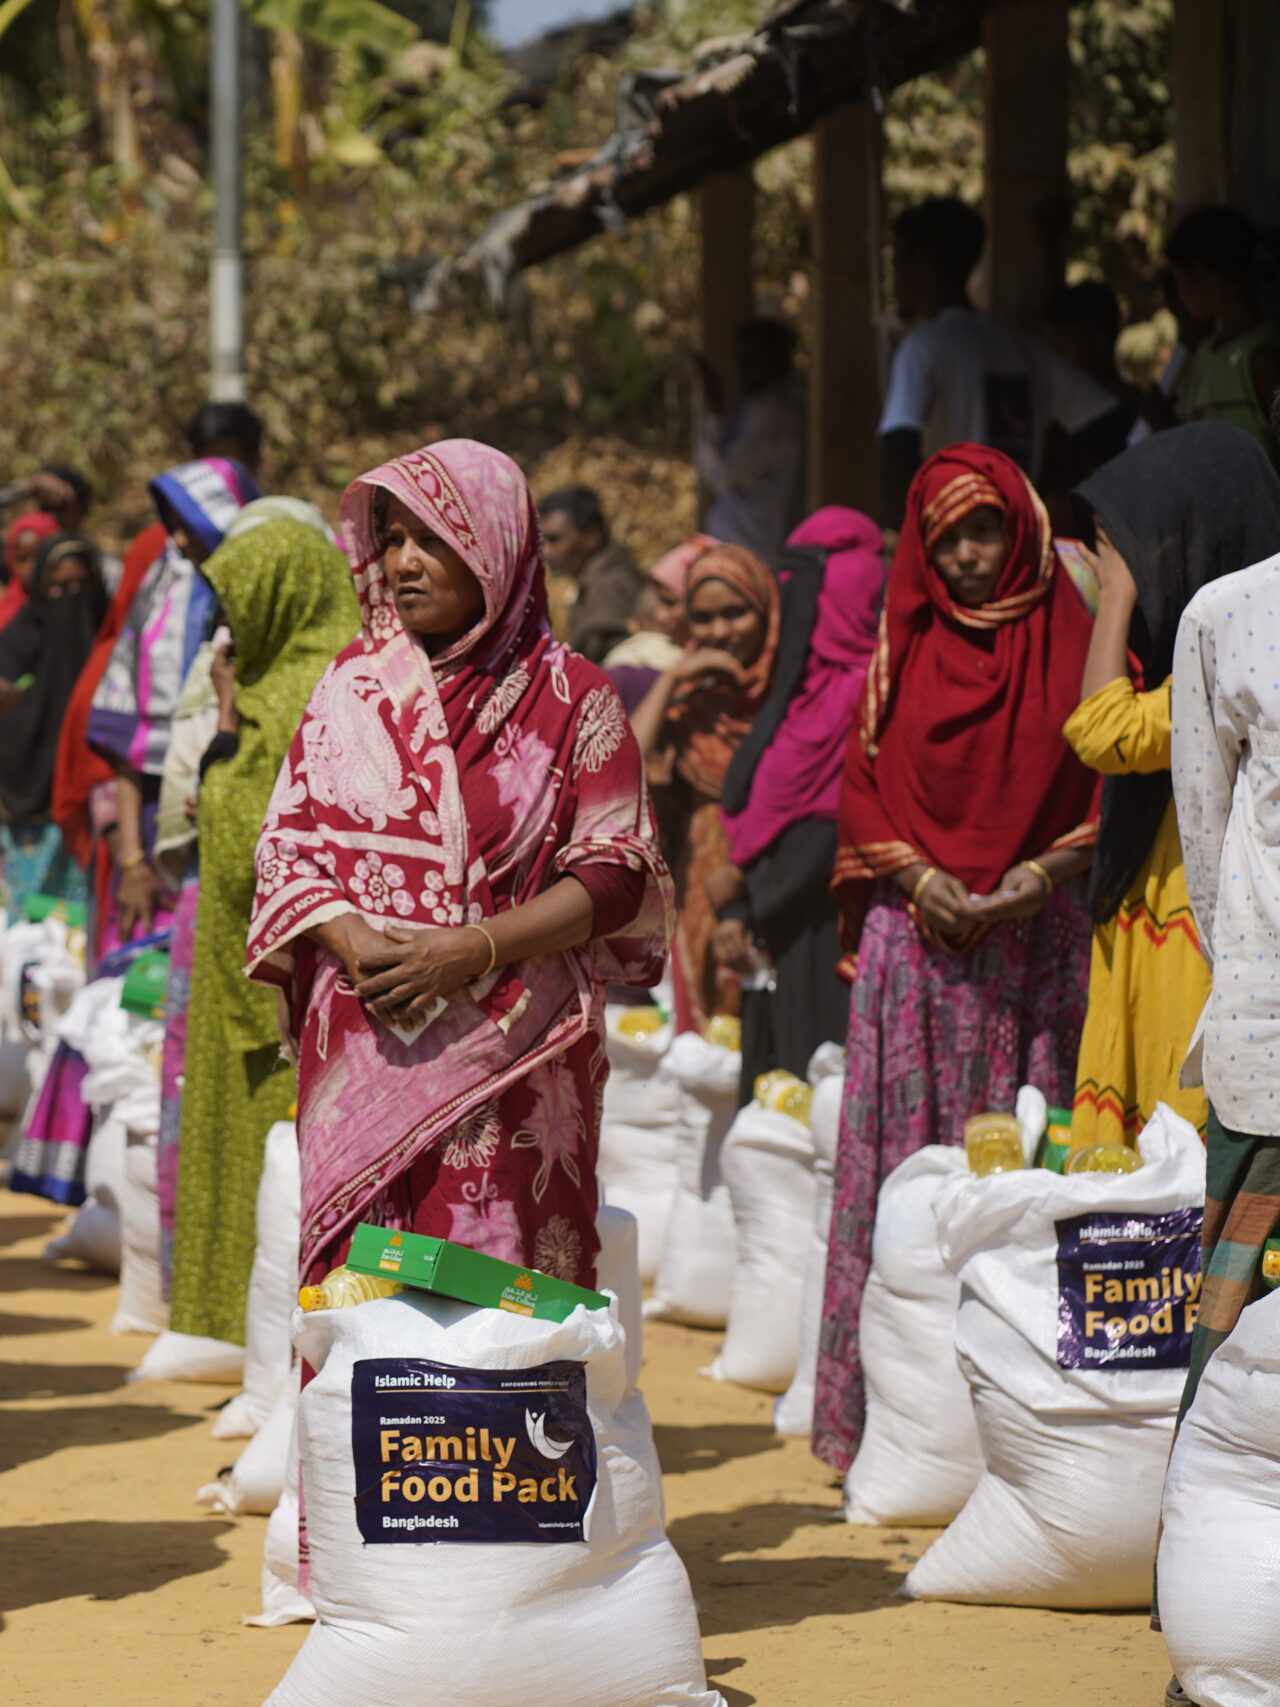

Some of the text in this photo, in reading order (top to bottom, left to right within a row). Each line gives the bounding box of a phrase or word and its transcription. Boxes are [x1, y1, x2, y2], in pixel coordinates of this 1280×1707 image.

[1079, 1224, 1121, 1239] Islamic
[1082, 1261, 1123, 1271] Ramadan
[1085, 1266, 1203, 1303] Family
[1085, 1301, 1173, 1338] Food
[1084, 1344, 1157, 1361] Bangladesh
[375, 1373, 457, 1389] Islamic Help
[380, 1415, 446, 1425] Ramadan 2025
[380, 1427, 517, 1470] Family
[380, 1467, 579, 1503] Food Pack
[382, 1515, 459, 1531] Bangladesh
